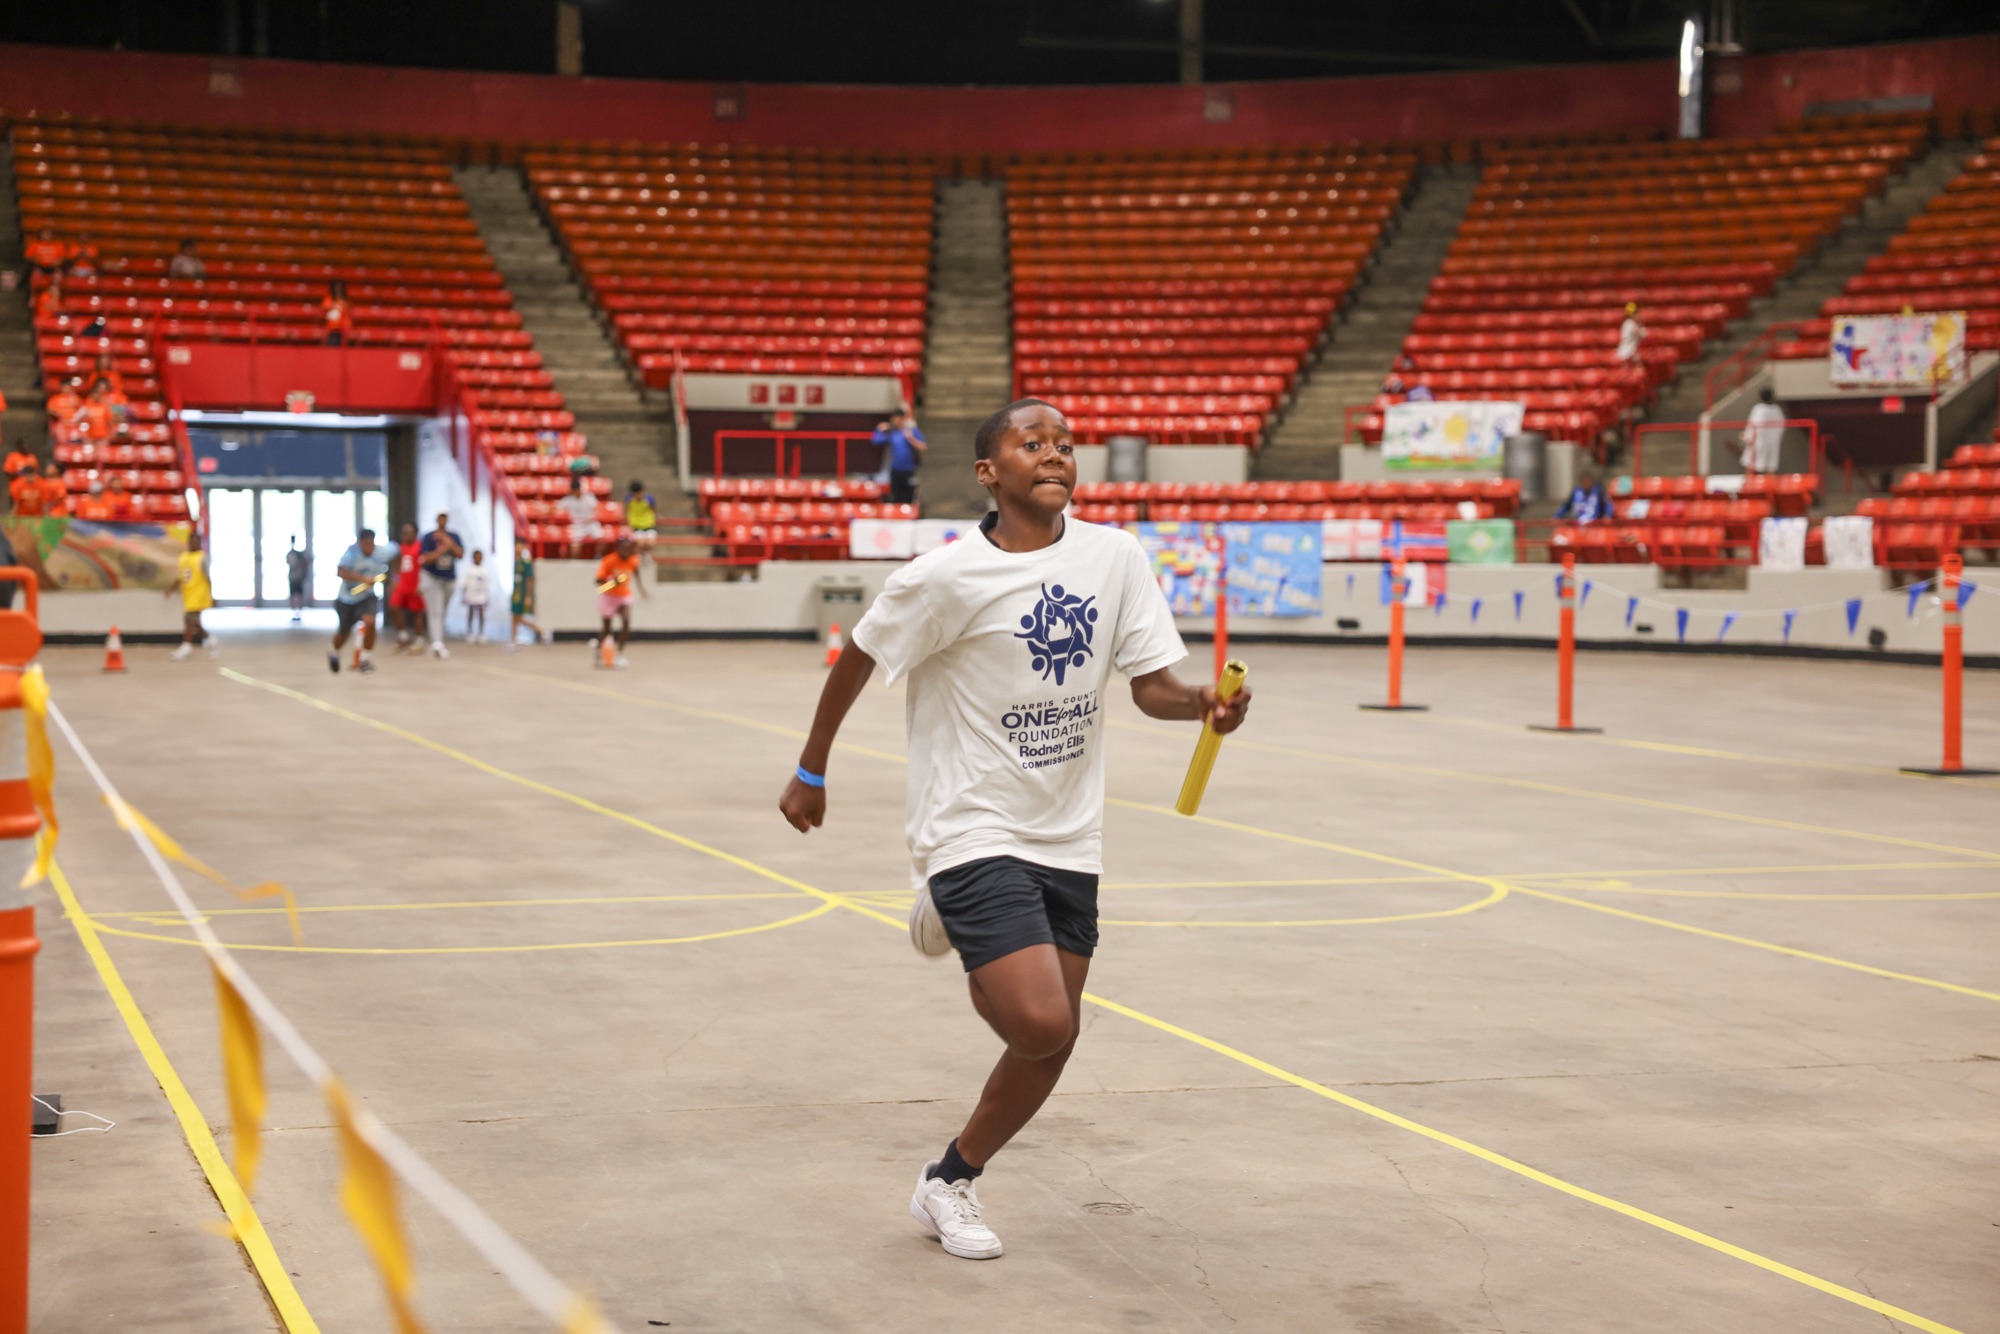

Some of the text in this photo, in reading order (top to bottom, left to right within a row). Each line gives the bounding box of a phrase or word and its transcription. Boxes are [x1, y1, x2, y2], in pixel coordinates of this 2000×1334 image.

[1012, 700, 1054, 711] HARRIS
[1009, 717, 1094, 742] FOUNDATION
[1019, 743, 1064, 757] Rodney
[1022, 748, 1085, 769] COMMISSIONER
